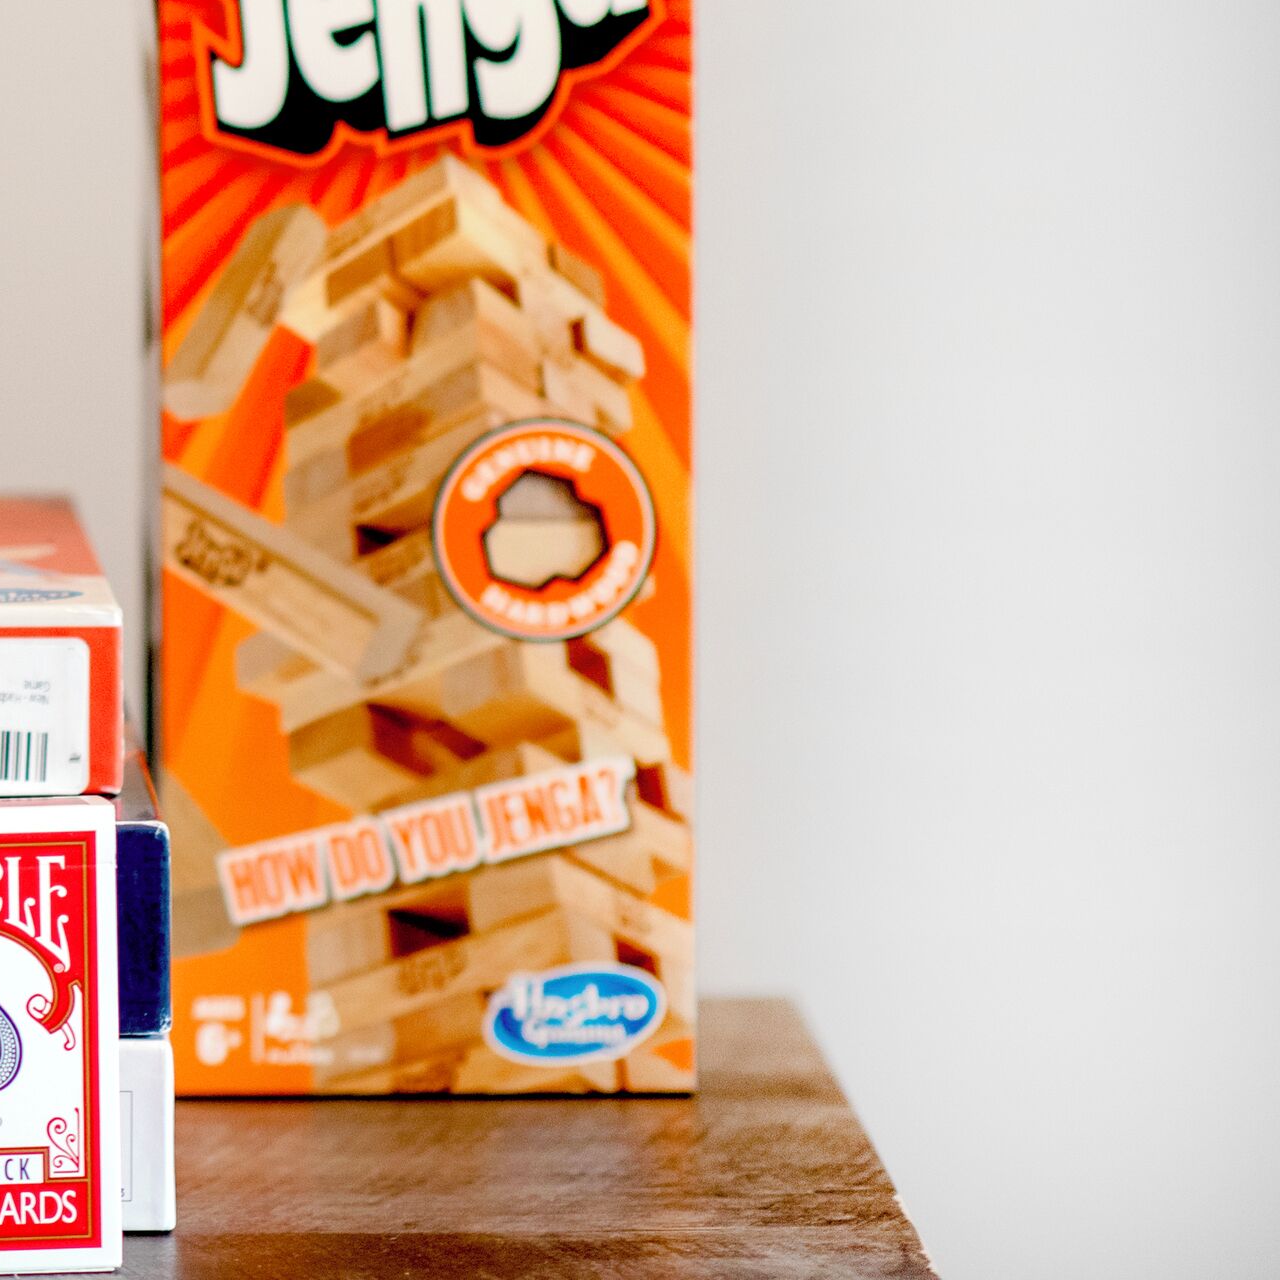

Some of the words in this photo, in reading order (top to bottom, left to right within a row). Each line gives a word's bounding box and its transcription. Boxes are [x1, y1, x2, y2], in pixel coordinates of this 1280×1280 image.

[226, 852, 321, 914] HOW
[328, 833, 388, 889] DO
[392, 800, 476, 874] YOU
[482, 765, 632, 862] JENGA?
